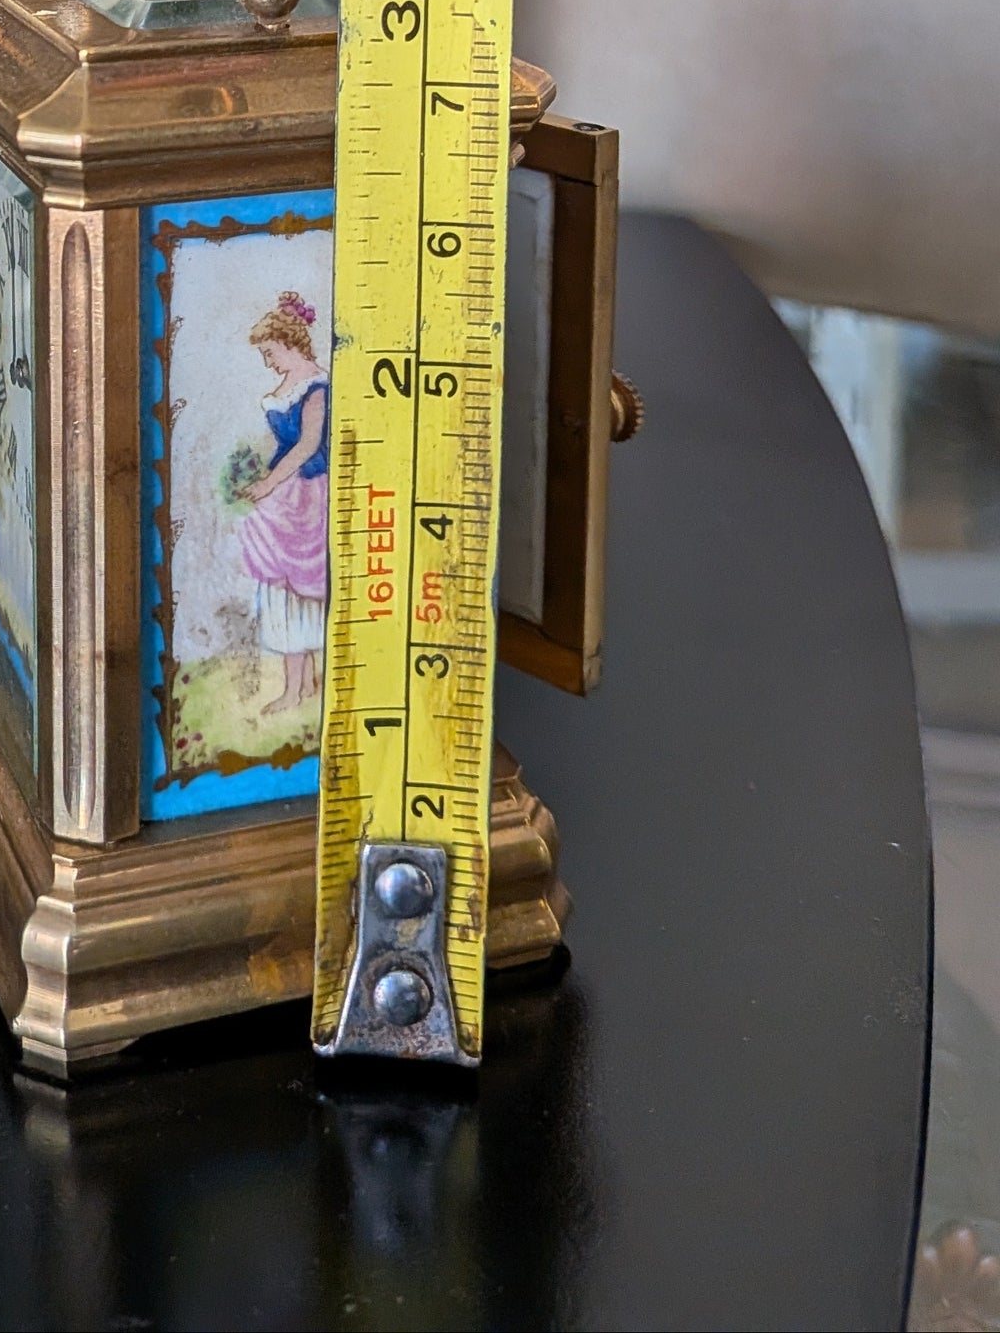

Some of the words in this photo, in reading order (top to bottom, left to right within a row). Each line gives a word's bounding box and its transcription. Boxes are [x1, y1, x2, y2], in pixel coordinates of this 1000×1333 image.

[381, 0, 421, 42] 3
[431, 91, 465, 116] 7
[427, 232, 462, 258] 6
[372, 358, 412, 398] 2
[424, 372, 458, 398] 5
[420, 513, 453, 540] 4
[415, 572, 442, 624] 5m
[415, 653, 450, 679] 3
[364, 717, 402, 736] 1
[411, 795, 445, 819] 2
